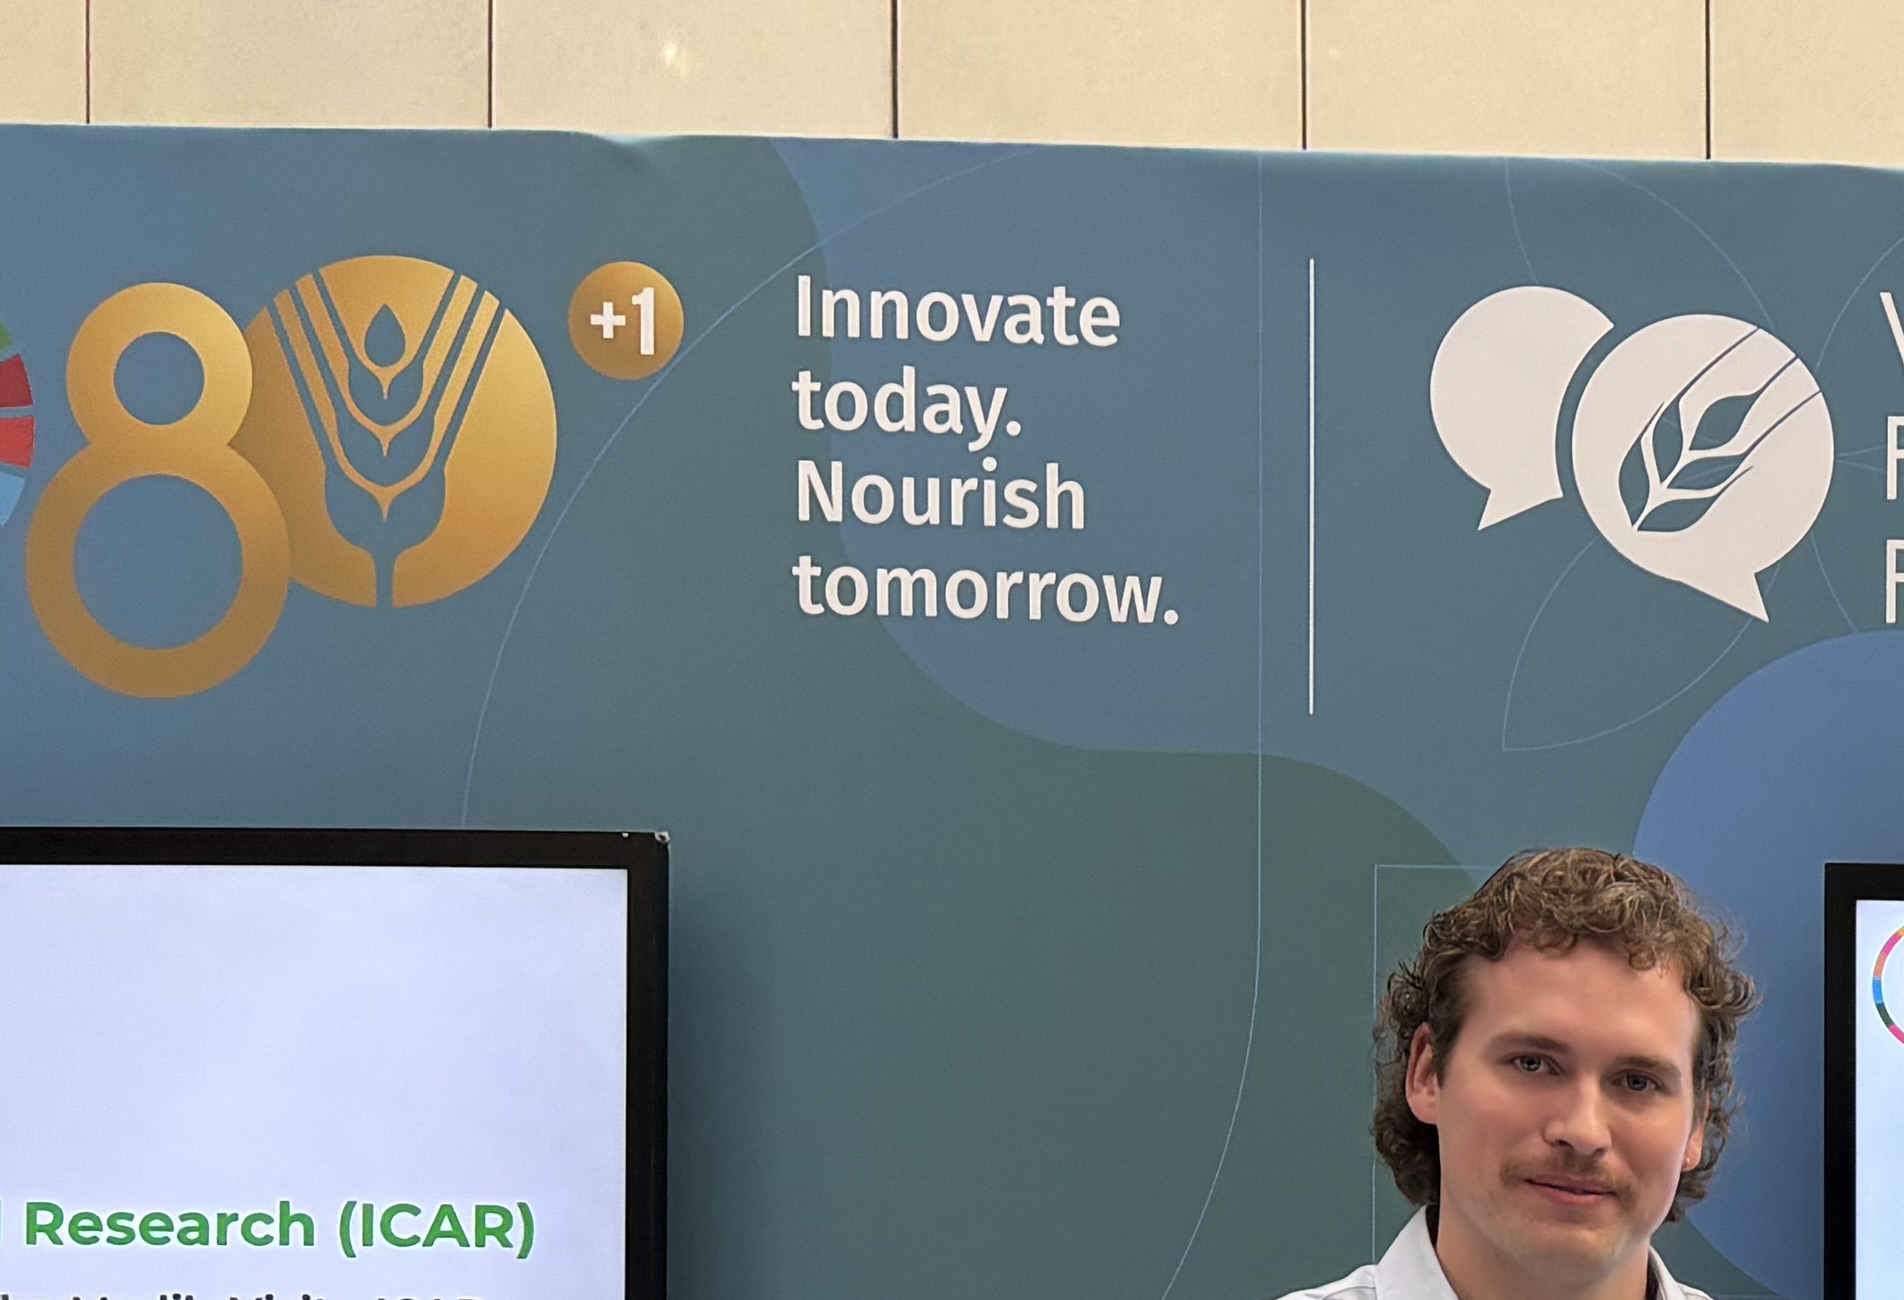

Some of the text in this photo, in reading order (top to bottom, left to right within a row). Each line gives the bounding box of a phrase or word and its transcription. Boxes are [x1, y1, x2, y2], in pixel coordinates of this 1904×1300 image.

[589, 286, 656, 356] +1
[799, 276, 1119, 346] Innovate
[792, 366, 1021, 452] today.
[799, 457, 1084, 529] Nourish
[792, 556, 1178, 624] tomorrow.
[26, 1201, 534, 1259] Research (ICAR)
